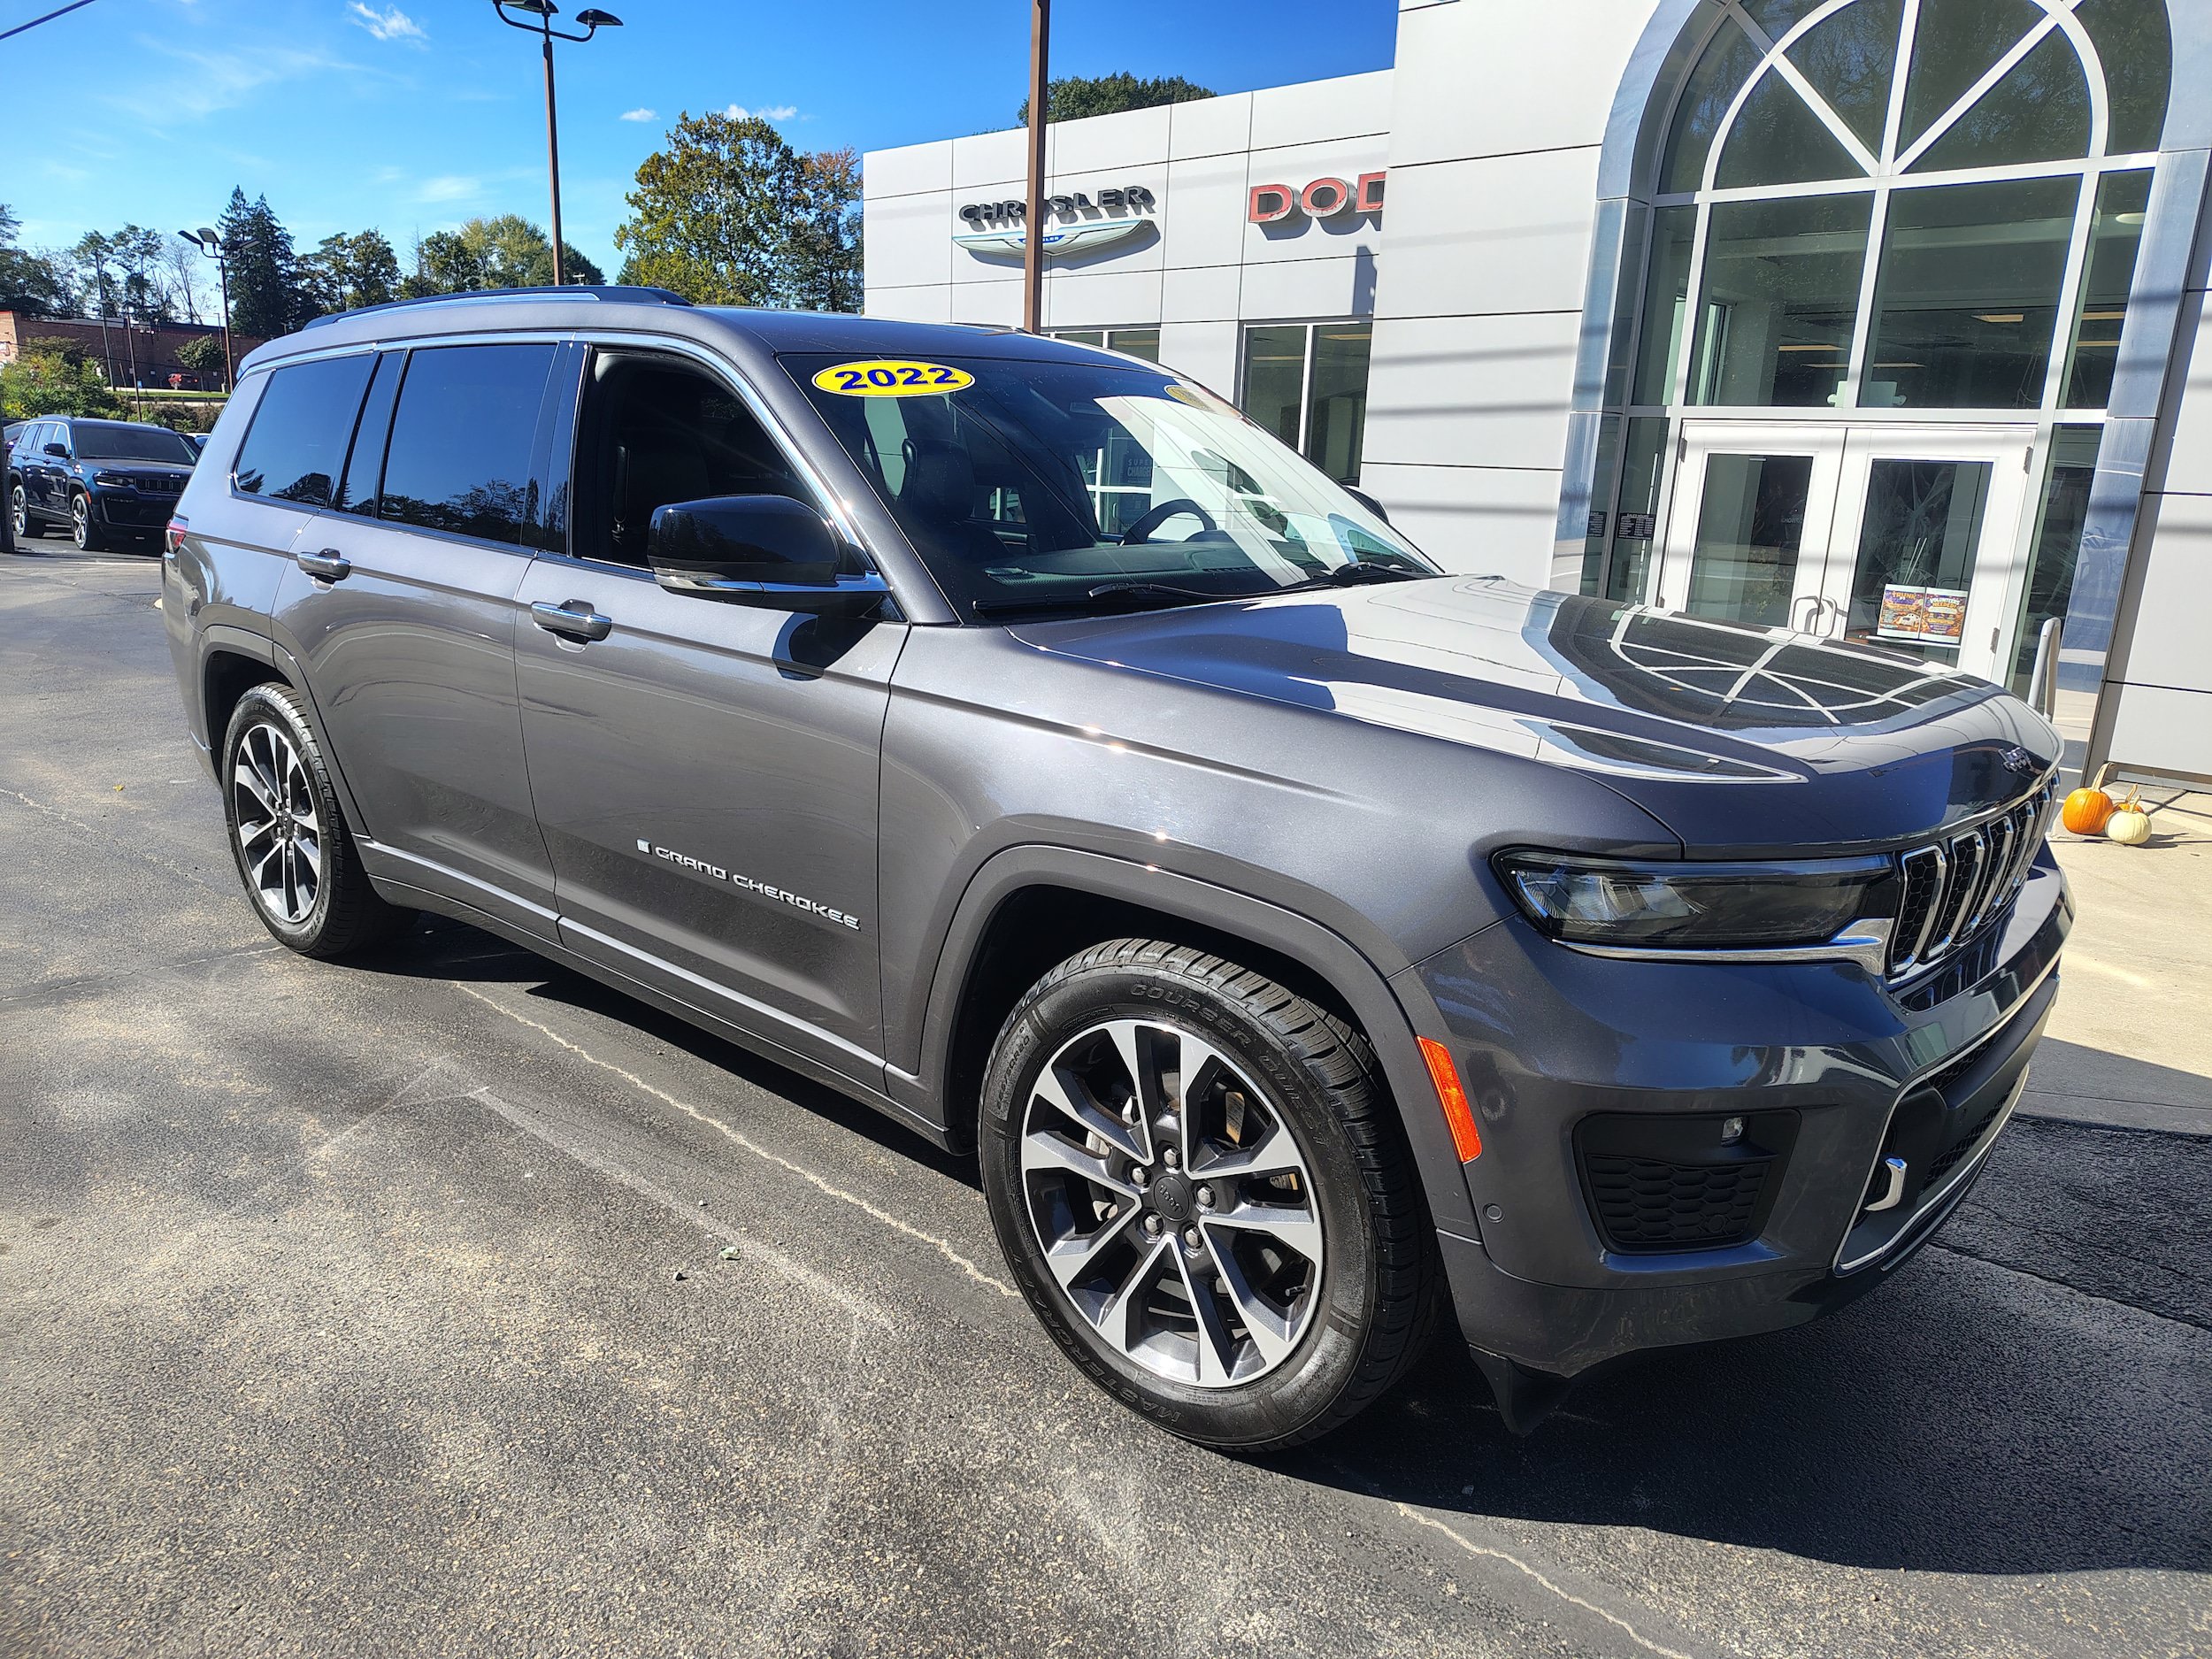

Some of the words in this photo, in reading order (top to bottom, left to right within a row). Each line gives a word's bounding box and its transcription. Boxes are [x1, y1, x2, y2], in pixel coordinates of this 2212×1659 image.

[958, 185, 1146, 222] CHRSLER
[1248, 172, 1386, 223] DOD
[834, 367, 960, 390] 2022
[655, 846, 727, 880] GRAND
[733, 874, 861, 931] CHEROKEE
